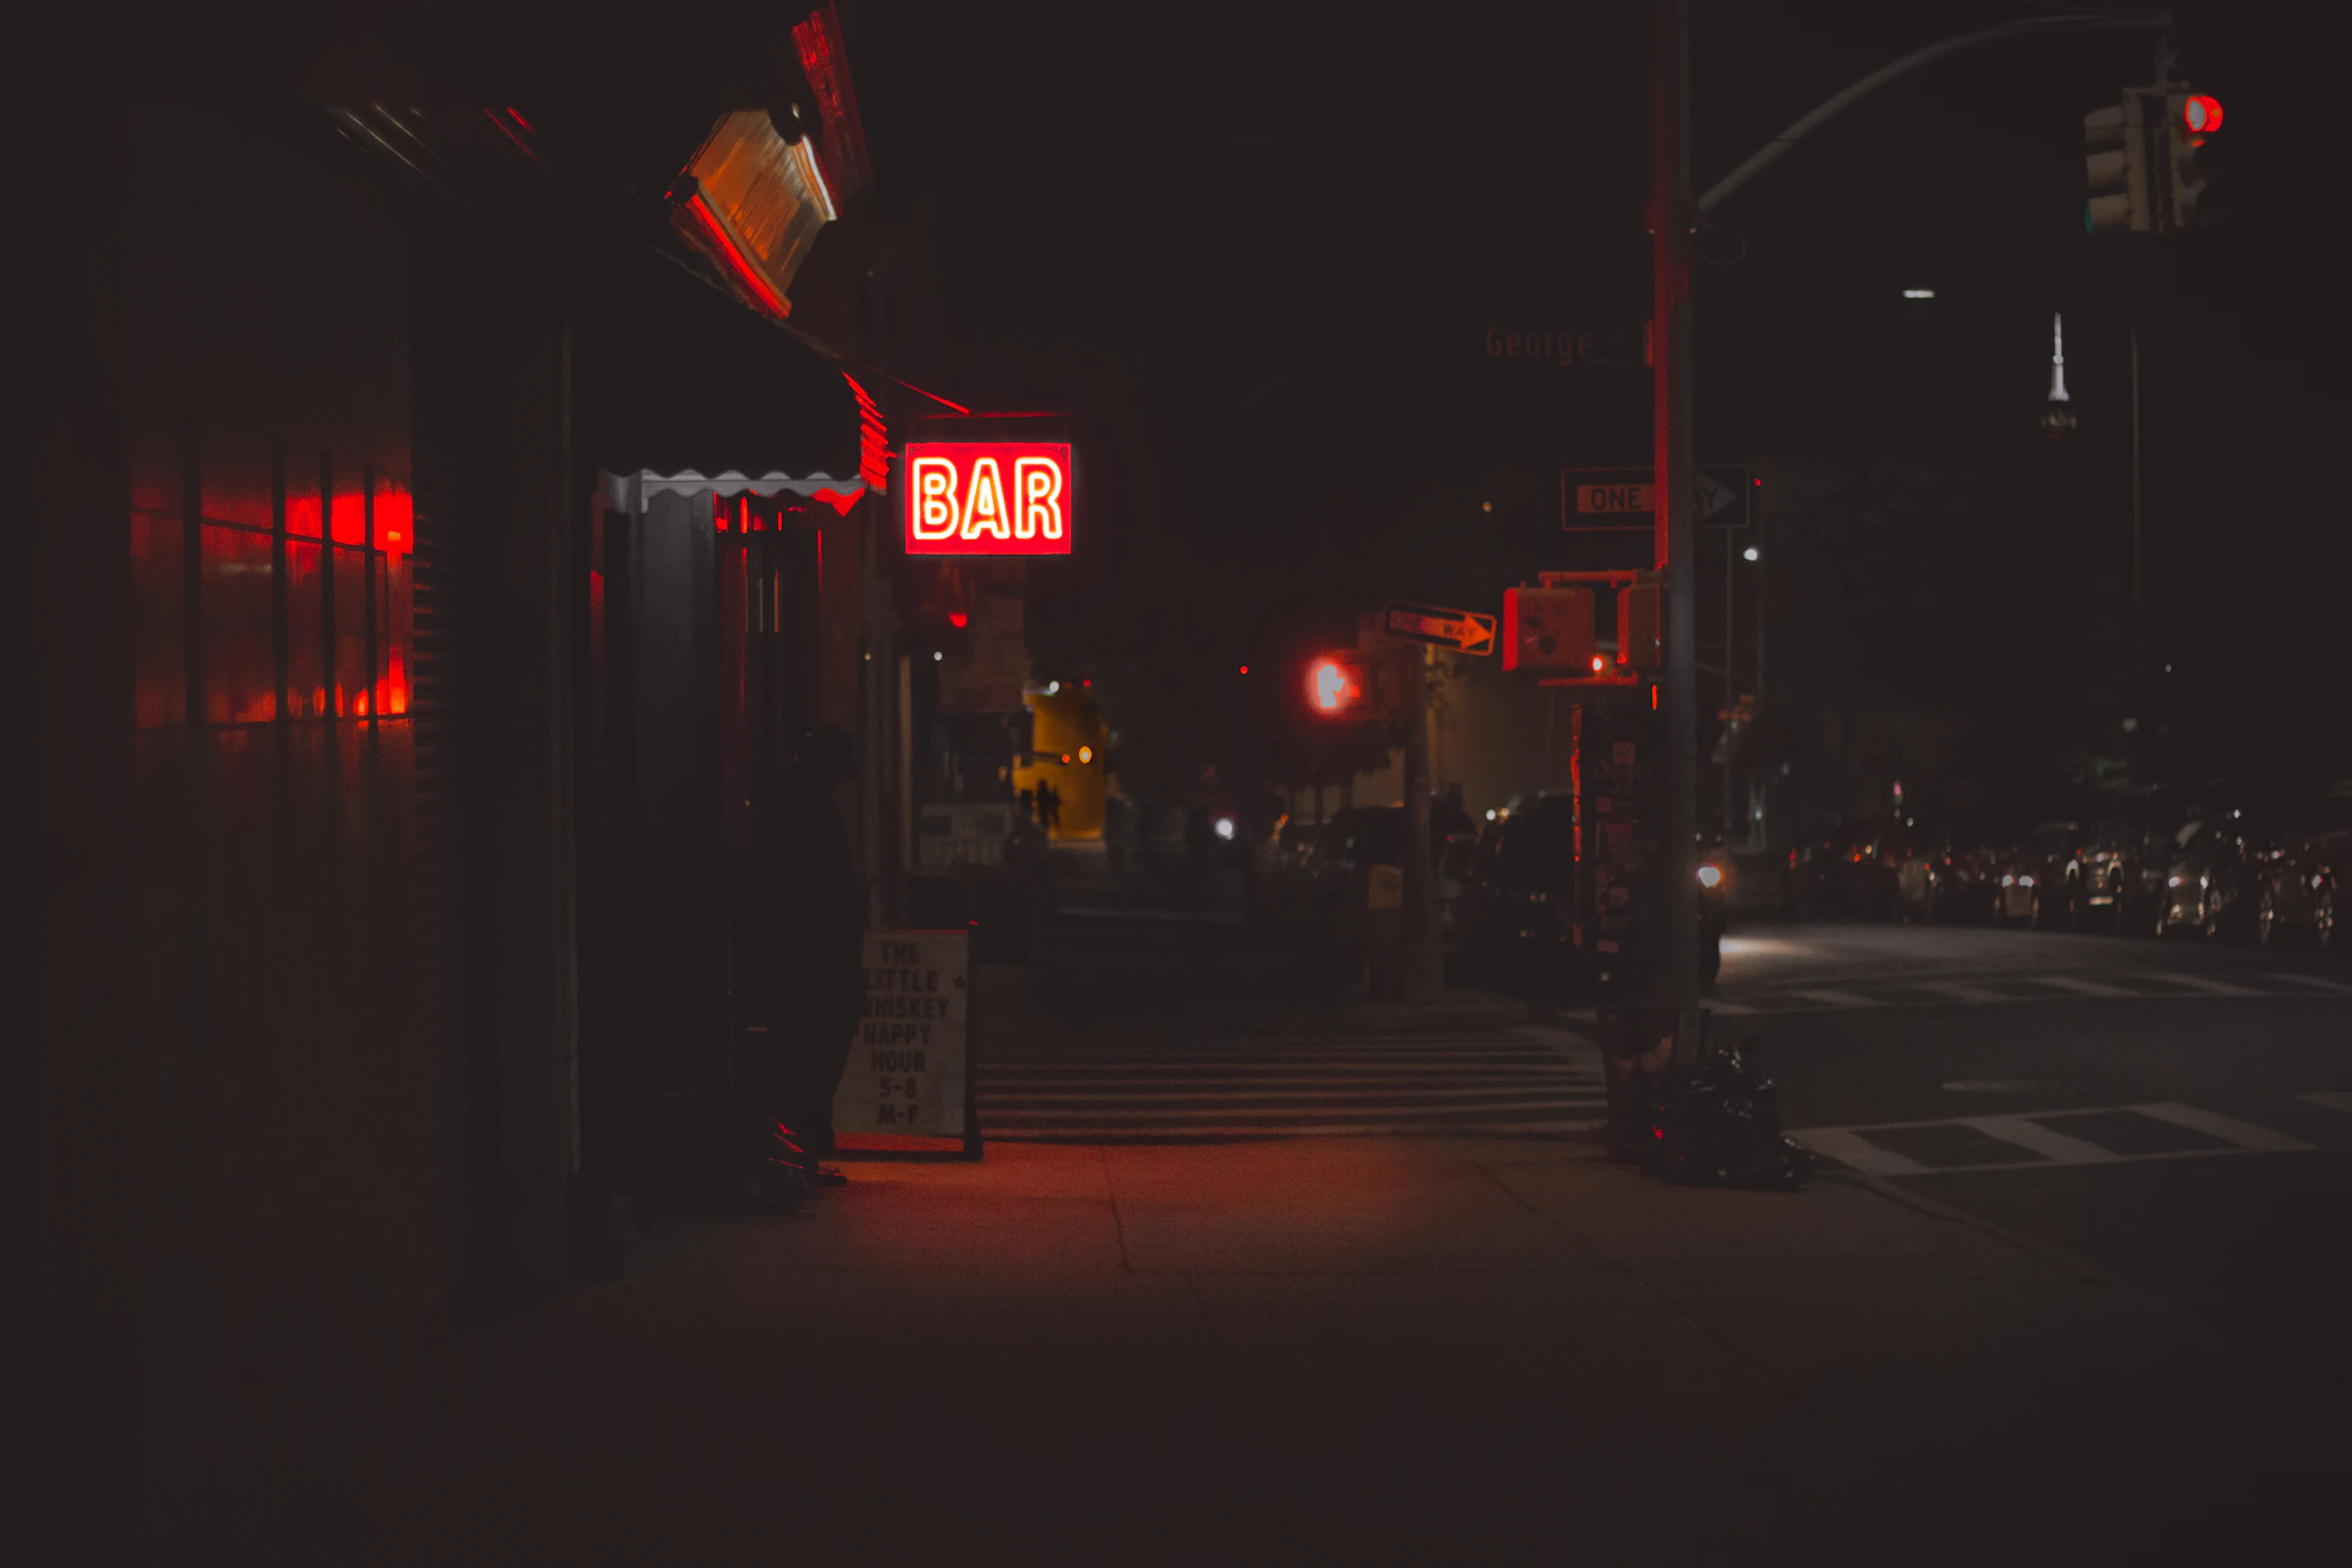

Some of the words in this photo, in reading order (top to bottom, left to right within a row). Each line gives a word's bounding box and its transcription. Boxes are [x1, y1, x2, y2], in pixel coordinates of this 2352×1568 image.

[1485, 326, 1594, 367] George
[912, 456, 1063, 540] BAR
[1590, 486, 1643, 511] ONE
[880, 941, 920, 964] THE
[864, 967, 939, 992] LITTLE
[863, 1023, 931, 1047] HAPPY
[870, 1051, 926, 1073] HOUR
[878, 1076, 916, 1099] 5-8
[877, 1103, 919, 1126] M-F
